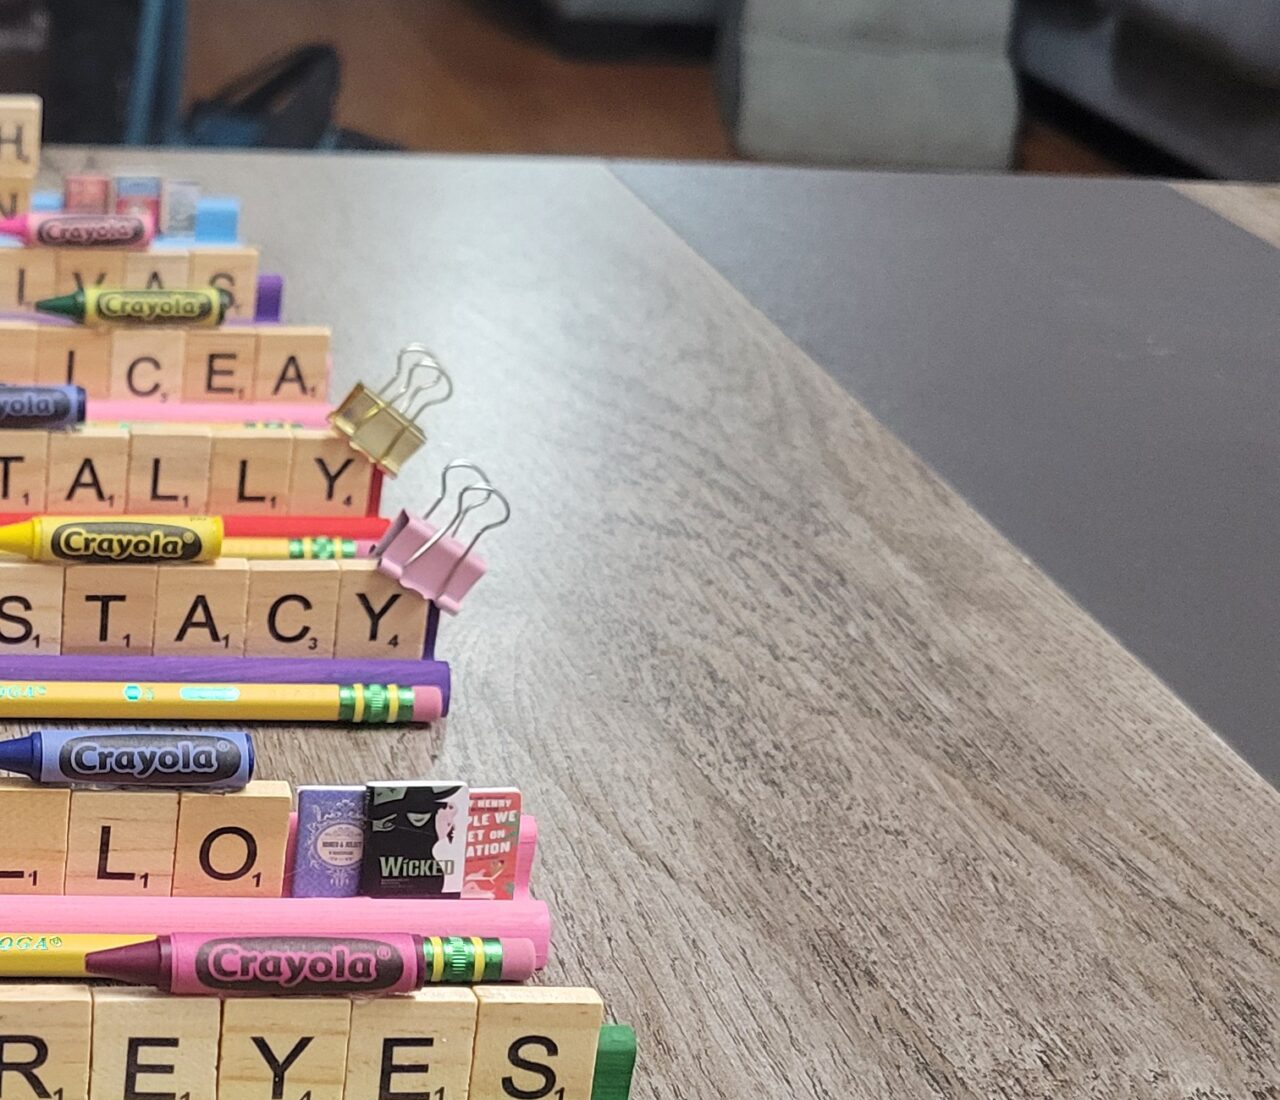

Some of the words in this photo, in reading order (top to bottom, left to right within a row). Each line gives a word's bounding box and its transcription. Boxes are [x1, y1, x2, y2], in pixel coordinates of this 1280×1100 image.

[103, 295, 200, 320] Crayola
[60, 527, 184, 559] Crayola
[72, 740, 219, 777] Crayola
[207, 935, 378, 984] Crayola
